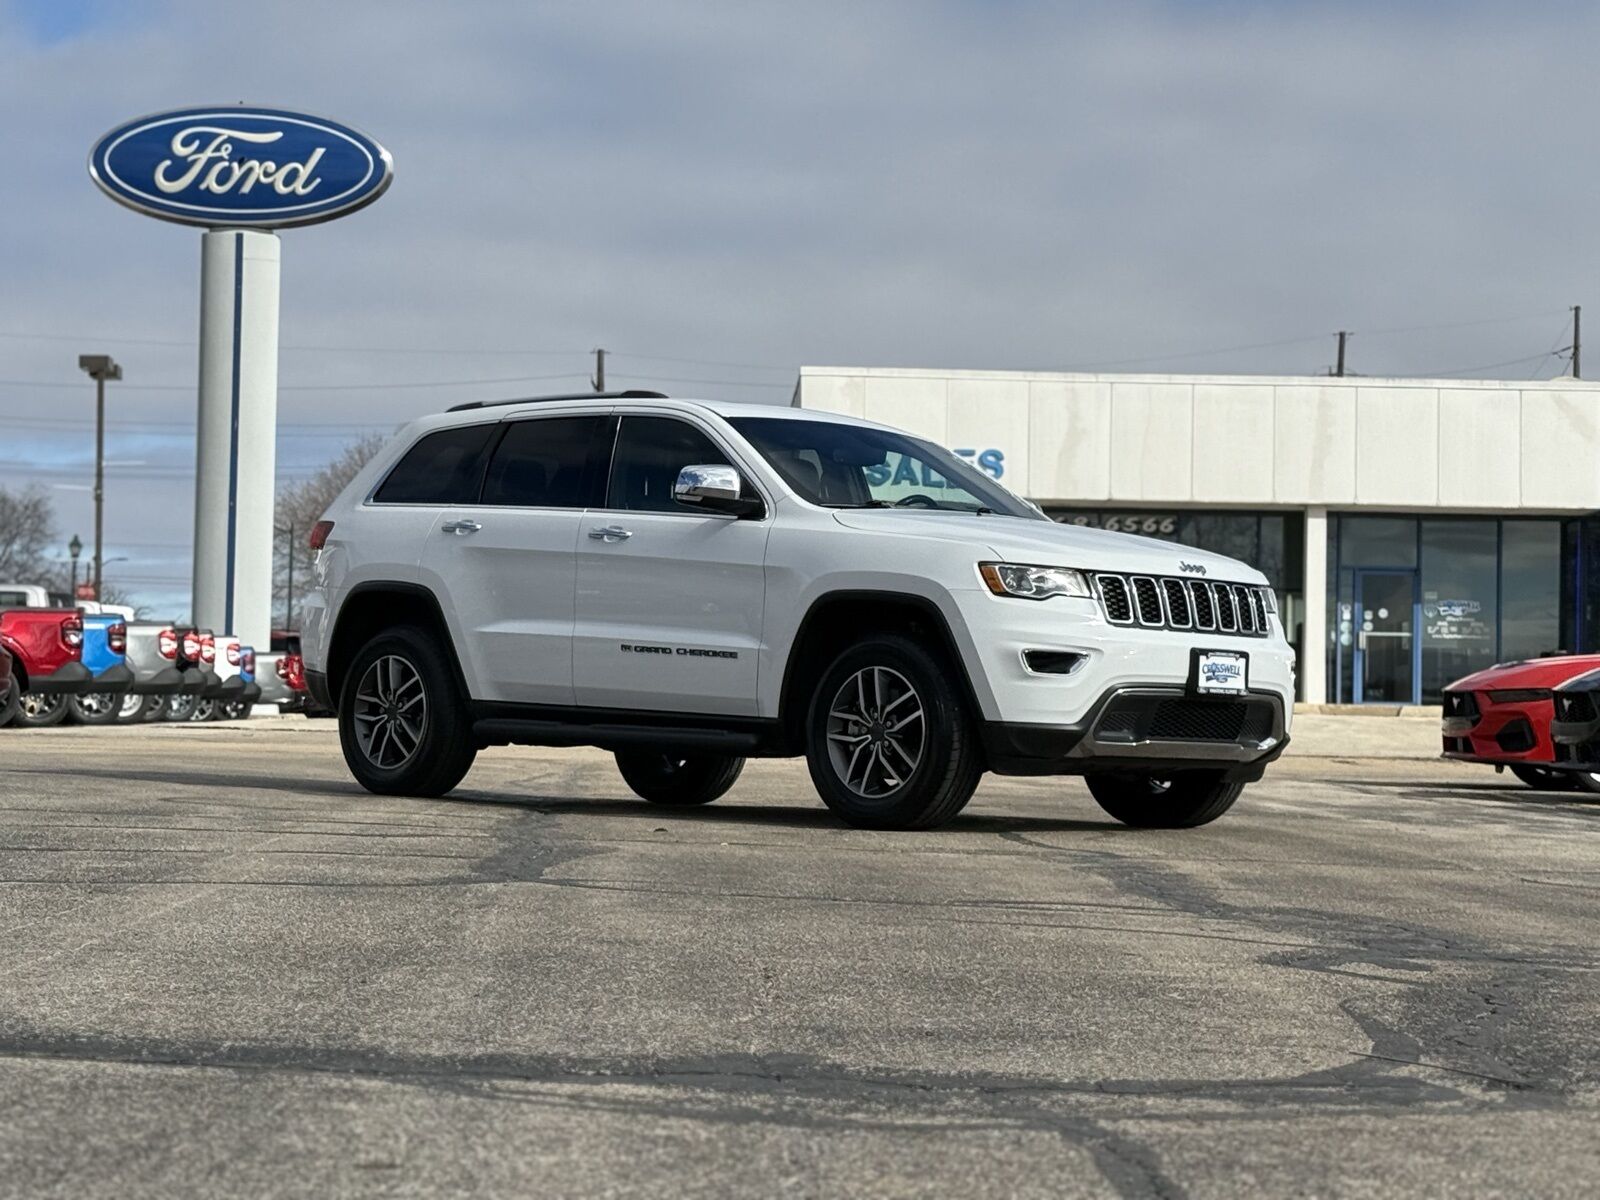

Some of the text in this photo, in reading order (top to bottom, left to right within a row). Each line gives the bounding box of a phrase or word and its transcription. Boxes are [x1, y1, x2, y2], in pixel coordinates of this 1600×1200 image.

[153, 126, 326, 195] Ford
[1105, 516, 1175, 533] 6566
[1179, 560, 1207, 576] Jeep
[634, 645, 738, 659] GRAND CHEROKEE
